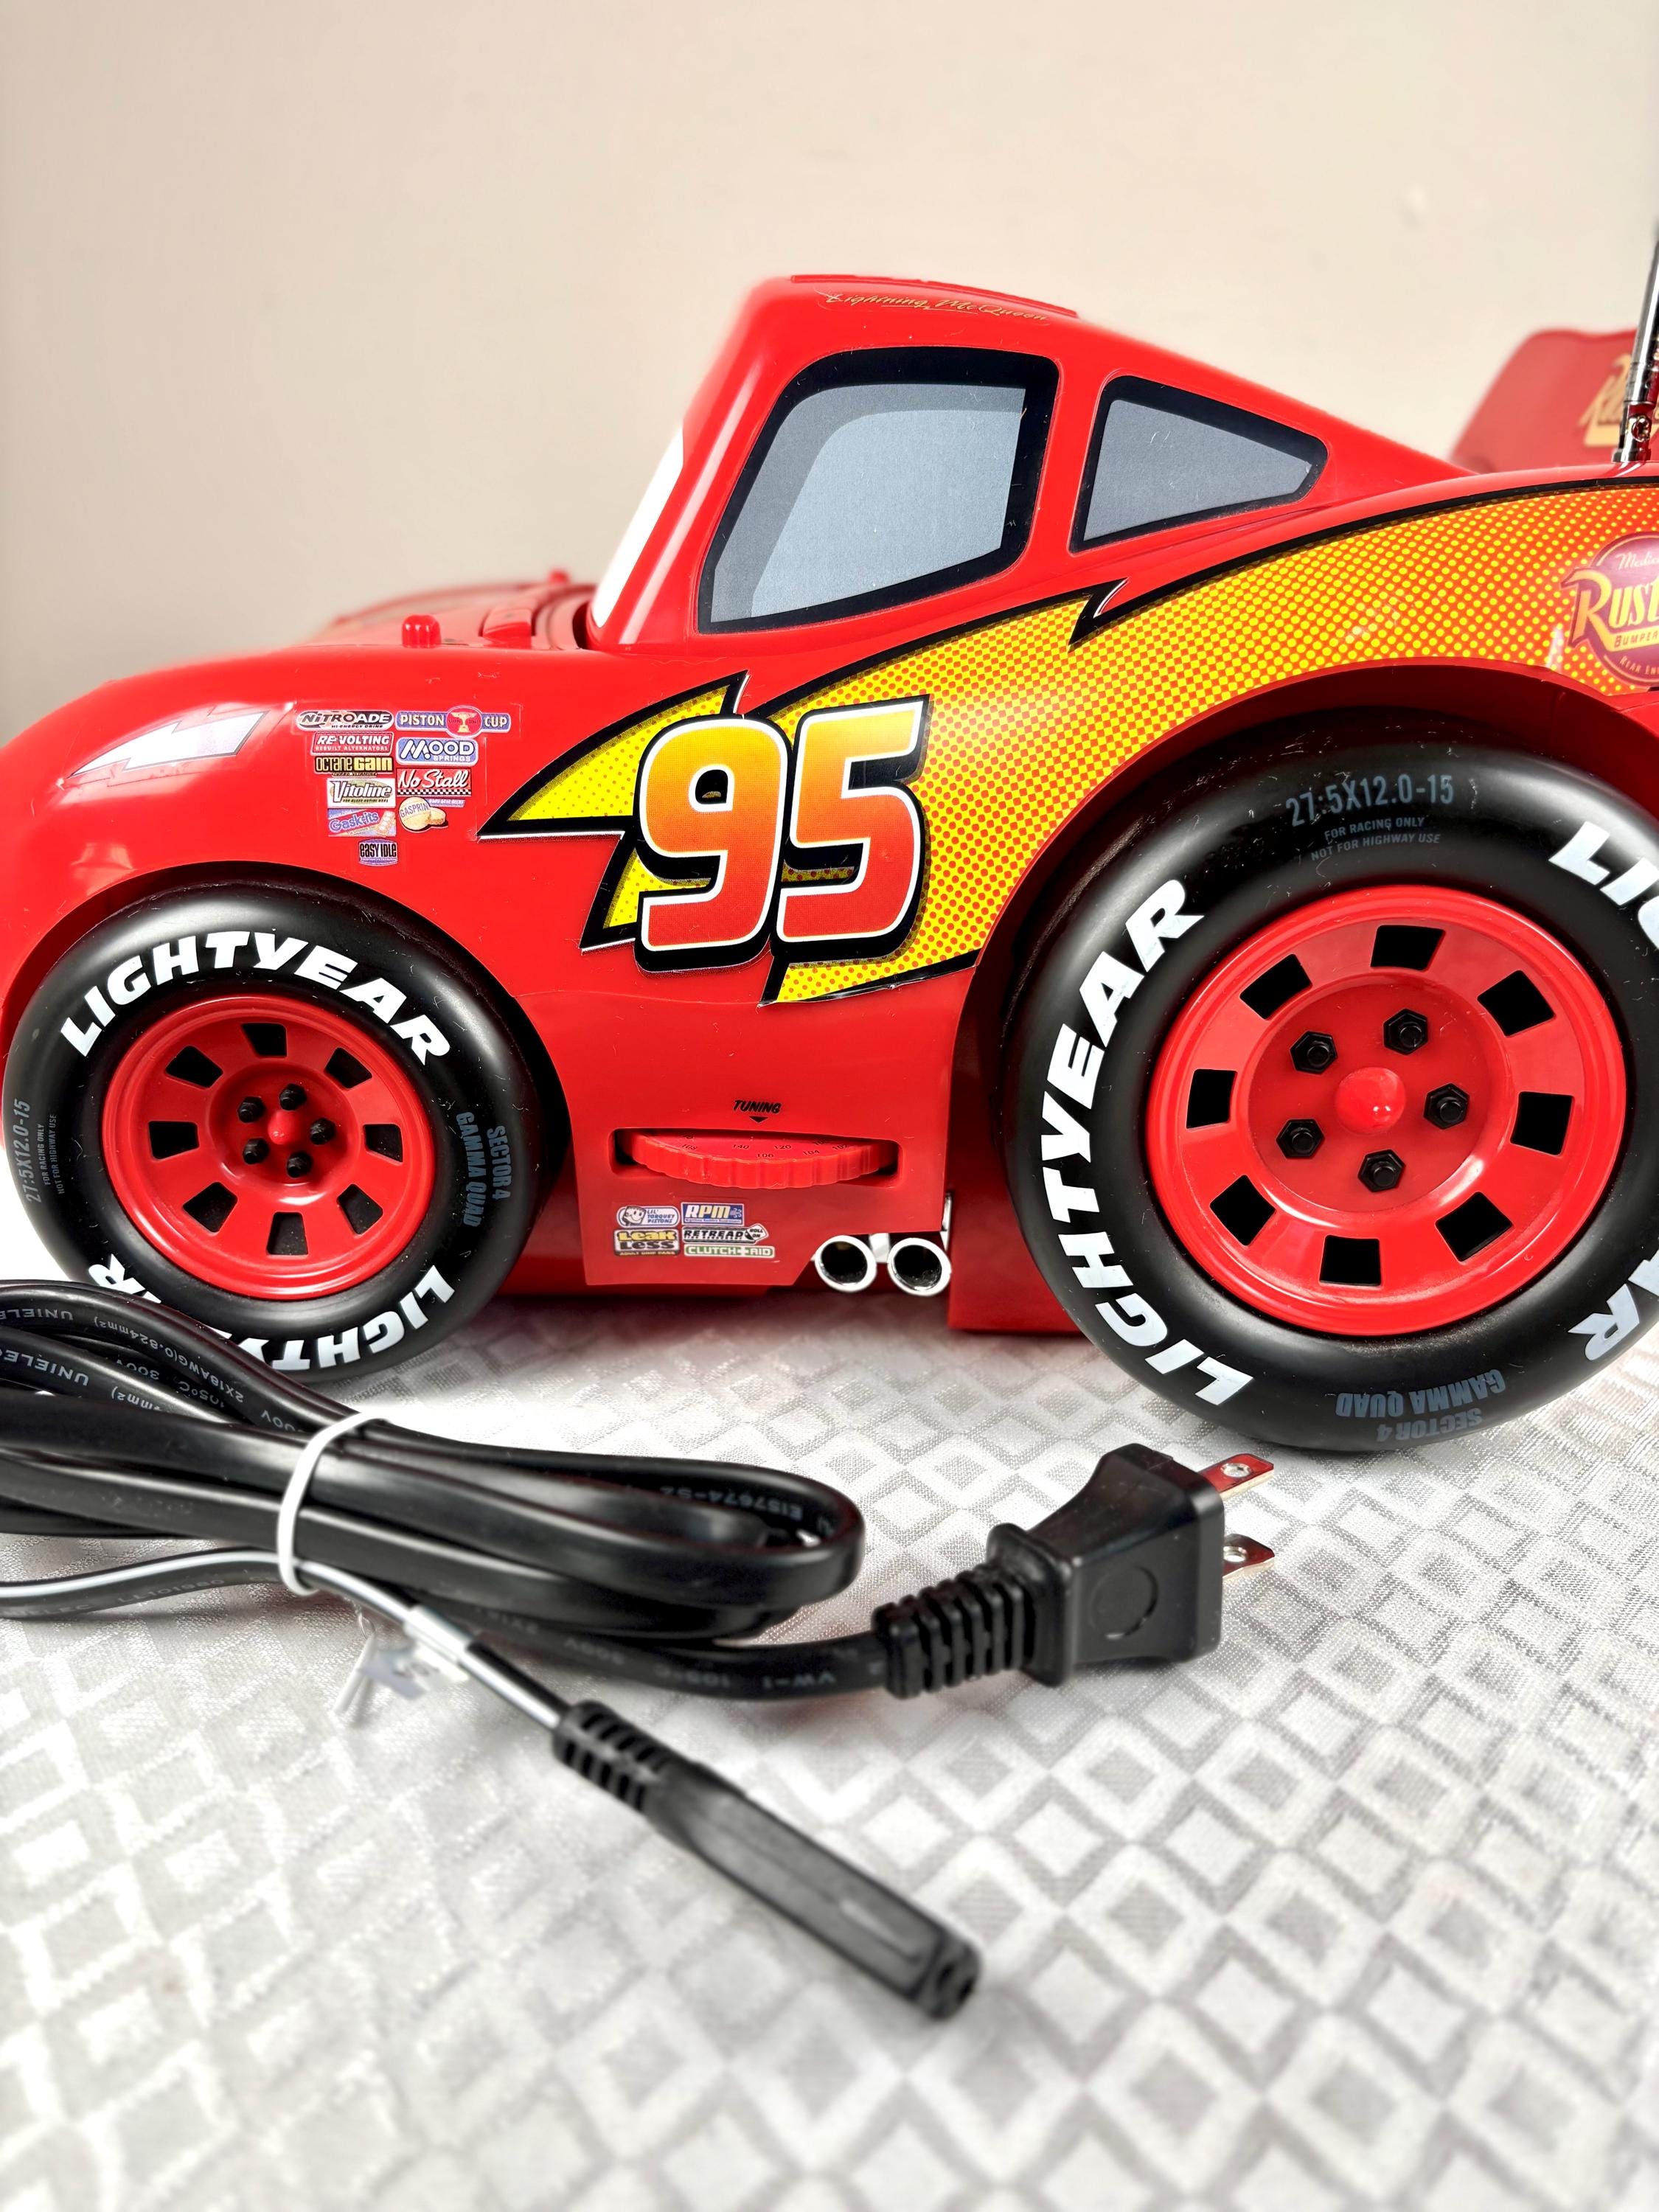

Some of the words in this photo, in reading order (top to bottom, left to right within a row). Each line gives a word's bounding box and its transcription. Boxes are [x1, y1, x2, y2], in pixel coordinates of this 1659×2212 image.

[400, 714, 444, 726] PISTON
[484, 716, 507, 728] CUP
[400, 739, 475, 760] MOOD
[397, 769, 421, 788] No
[422, 769, 470, 788] Stall
[330, 780, 393, 803] Vitoline
[400, 802, 430, 818] GASPRIN
[637, 698, 928, 960] 95
[1324, 827, 1346, 841] FOR
[1349, 818, 1392, 834] RACING
[1396, 817, 1425, 828] ONLY
[1311, 846, 1333, 861] NOT
[1337, 838, 1359, 853] FOR
[1363, 833, 1416, 847] HIGHWAY
[1419, 833, 1441, 844] USE
[60, 931, 451, 1066] LIGHTYEAR
[733, 1099, 782, 1114] TUNING
[37, 1124, 45, 1142] ONLY
[49, 1114, 58, 1129] USE
[49, 1130, 58, 1163] HIGHWAY
[456, 1112, 487, 1178] GAMMA
[1041, 879, 1253, 1406] LIGHTYEAR
[38, 1144, 47, 1171] RACING
[487, 1125, 512, 1188] SECTOR
[41, 1171, 52, 1186] FOR
[51, 1164, 61, 1179] FOR
[55, 1180, 66, 1194] NOT
[492, 1189, 511, 1200] 4
[462, 1181, 487, 1227] QUAD
[1408, 1368, 1506, 1415] GAMMA
[1335, 1391, 1405, 1418] QUAD
[1377, 1424, 1393, 1442] 4
[1394, 1408, 1483, 1441] SECTOR
